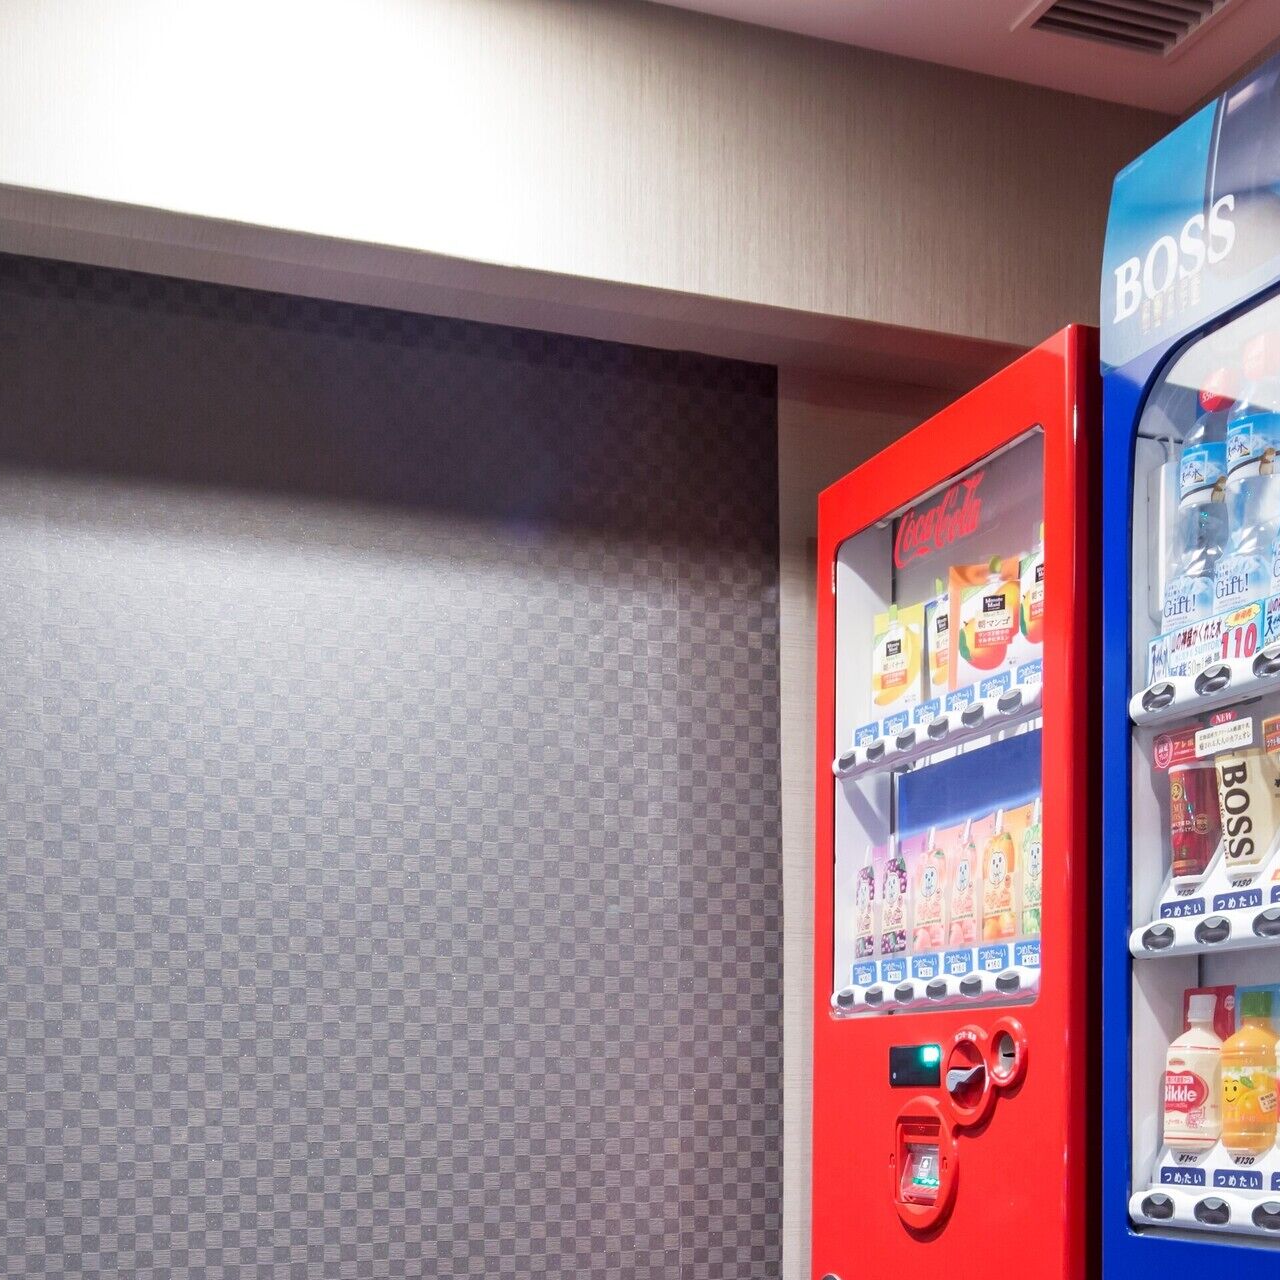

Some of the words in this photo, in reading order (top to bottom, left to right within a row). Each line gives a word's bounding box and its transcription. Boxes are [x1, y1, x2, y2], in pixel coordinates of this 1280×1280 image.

[1112, 194, 1236, 325] BOSS
[1215, 573, 1249, 600] Gift!
[1163, 594, 1196, 619] Gift!
[1221, 622, 1258, 660] 110
[1214, 712, 1234, 725] NEW
[1221, 759, 1256, 860] BOSS
[1163, 904, 1202, 918] つめたい
[1217, 895, 1259, 910] つめたい
[1164, 1171, 1203, 1184] つめたい
[1217, 1174, 1259, 1188] つめたい
